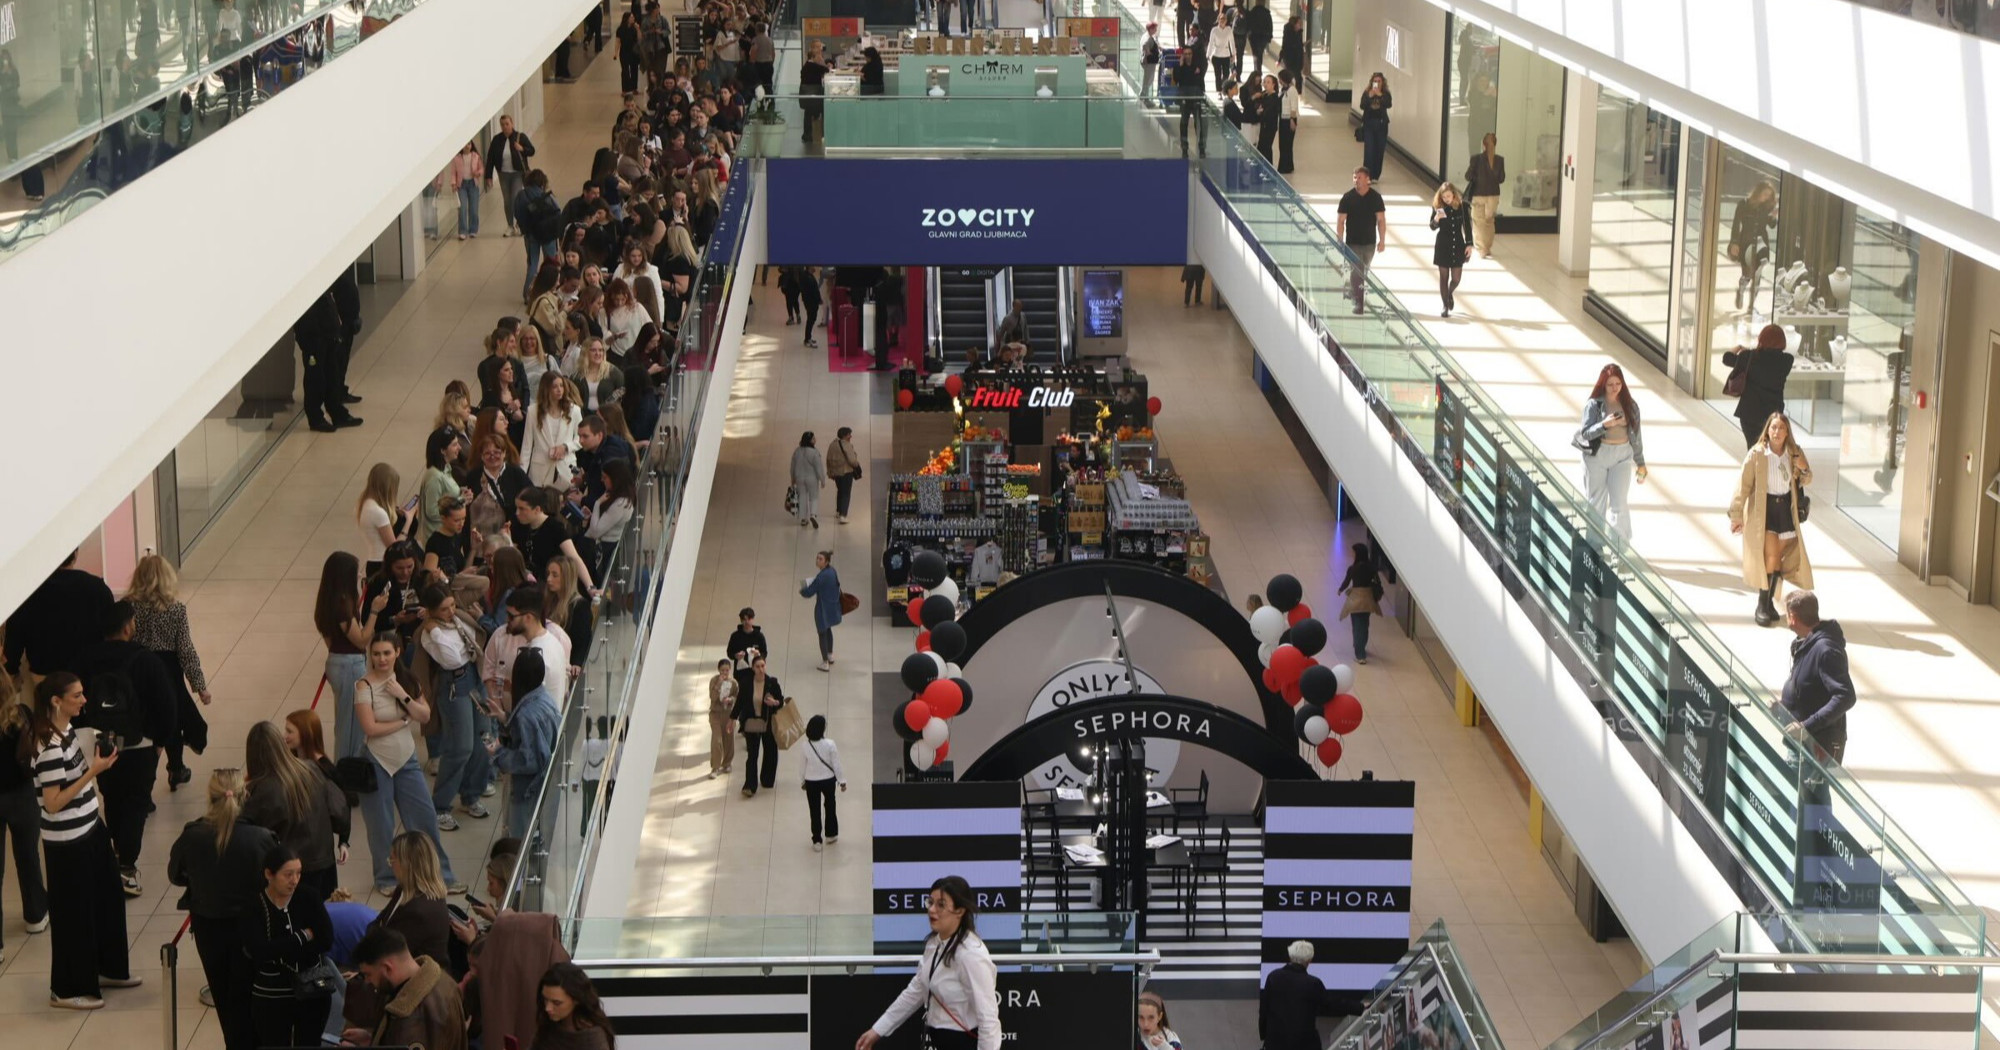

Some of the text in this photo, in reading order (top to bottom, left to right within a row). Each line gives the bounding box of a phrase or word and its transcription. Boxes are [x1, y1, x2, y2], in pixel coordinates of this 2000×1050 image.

[961, 61, 1023, 75] CHARM
[928, 230, 1027, 238] GLAVNI GRAD LJUBIMACA
[972, 386, 1075, 408] Fruit Club
[1052, 673, 1119, 707] ONLY
[1683, 666, 1711, 707] SEPHORA
[1074, 711, 1211, 738] SEPHORA
[1749, 792, 1771, 826] SEPHORA
[1818, 817, 1855, 871] SEPHORA
[888, 892, 1006, 909] SEPRA
[1278, 890, 1396, 907] SEPHORA
